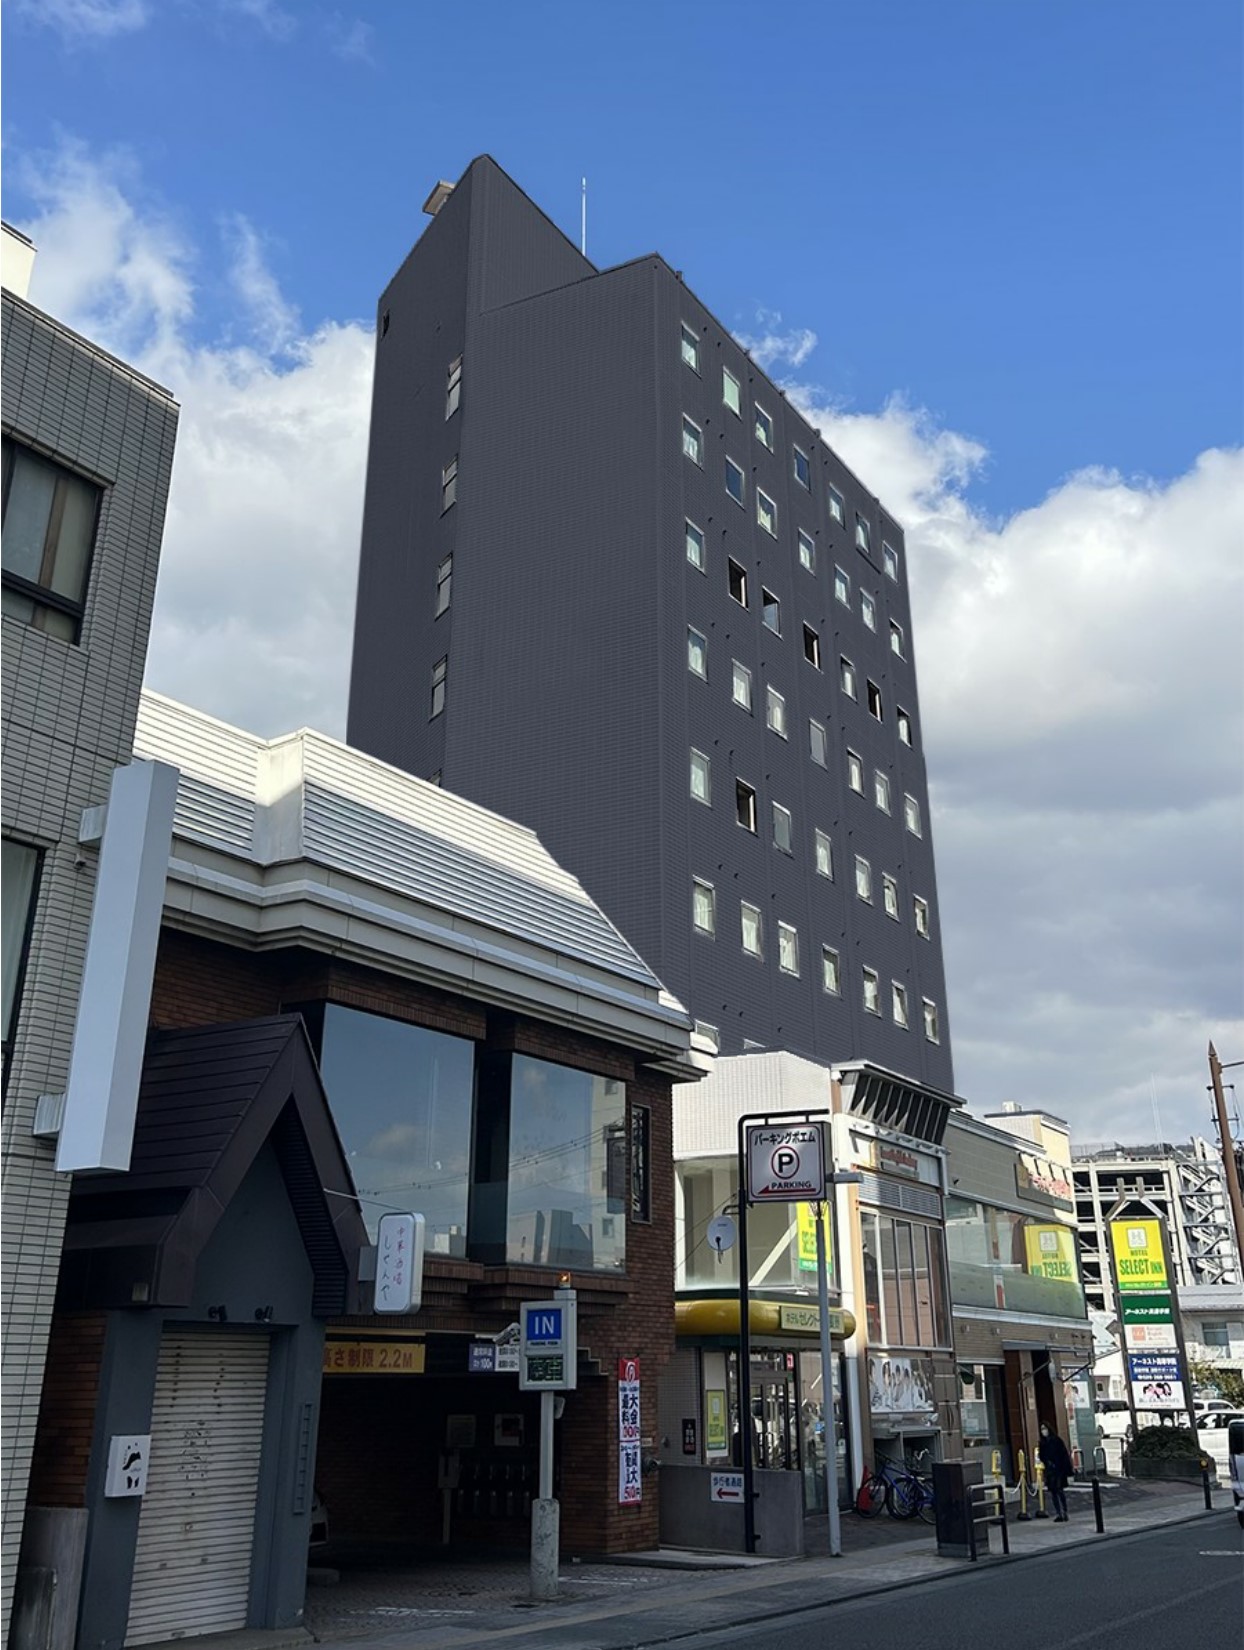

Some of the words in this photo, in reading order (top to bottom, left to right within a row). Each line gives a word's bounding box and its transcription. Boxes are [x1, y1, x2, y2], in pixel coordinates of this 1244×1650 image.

[754, 1131, 817, 1146] パーキングポエム
[778, 1153, 795, 1174] P
[771, 1181, 812, 1189] PARKING
[1119, 1258, 1150, 1276] SELECT
[534, 1315, 555, 1335] IN
[378, 1348, 414, 1369] 2.2M
